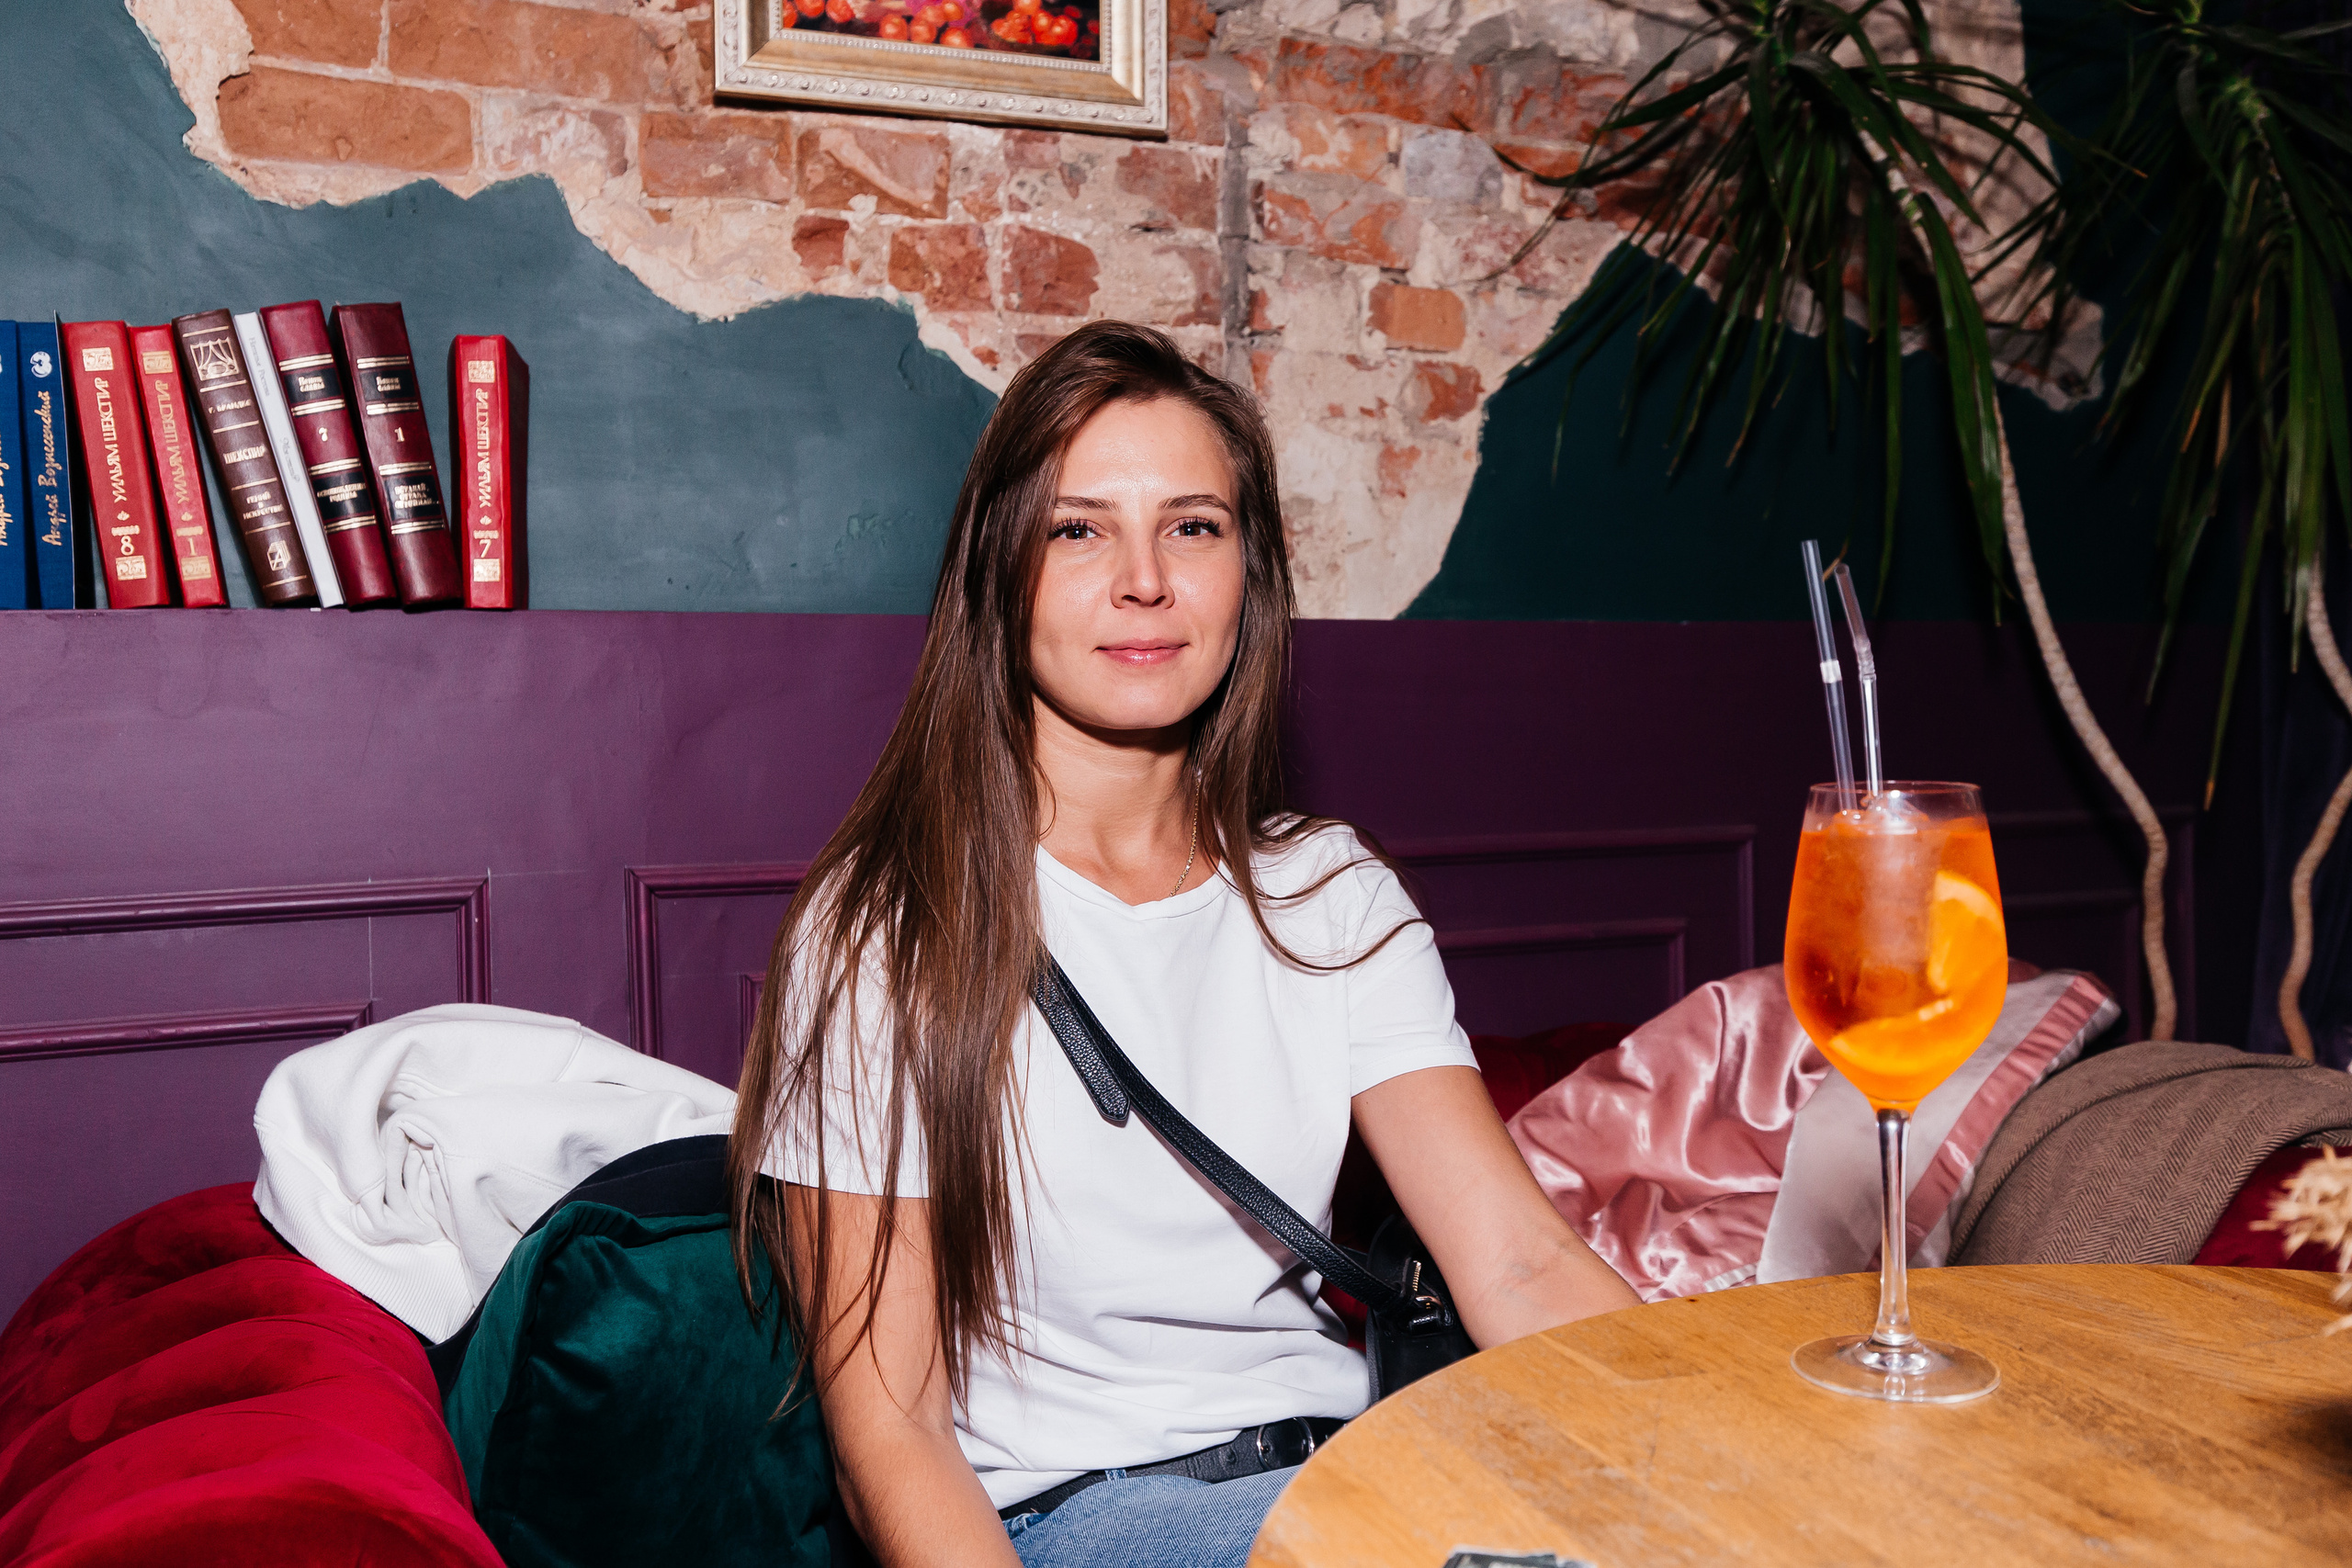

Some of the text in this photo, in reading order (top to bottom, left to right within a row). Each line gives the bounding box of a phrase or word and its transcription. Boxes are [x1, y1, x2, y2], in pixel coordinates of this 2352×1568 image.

[95, 377, 128, 503] УИЛЬЯМ ШЕКСПИР
[154, 379, 190, 504] УИЛЬЯМ ШЕКСПИР
[394, 426, 405, 442] 1
[222, 444, 267, 465] ШЕКСПИР
[475, 388, 492, 509] УИЛЬЯМ ШЕКСПИР
[120, 535, 135, 556] 8
[187, 537, 198, 557] 1
[479, 538, 492, 558] 7
